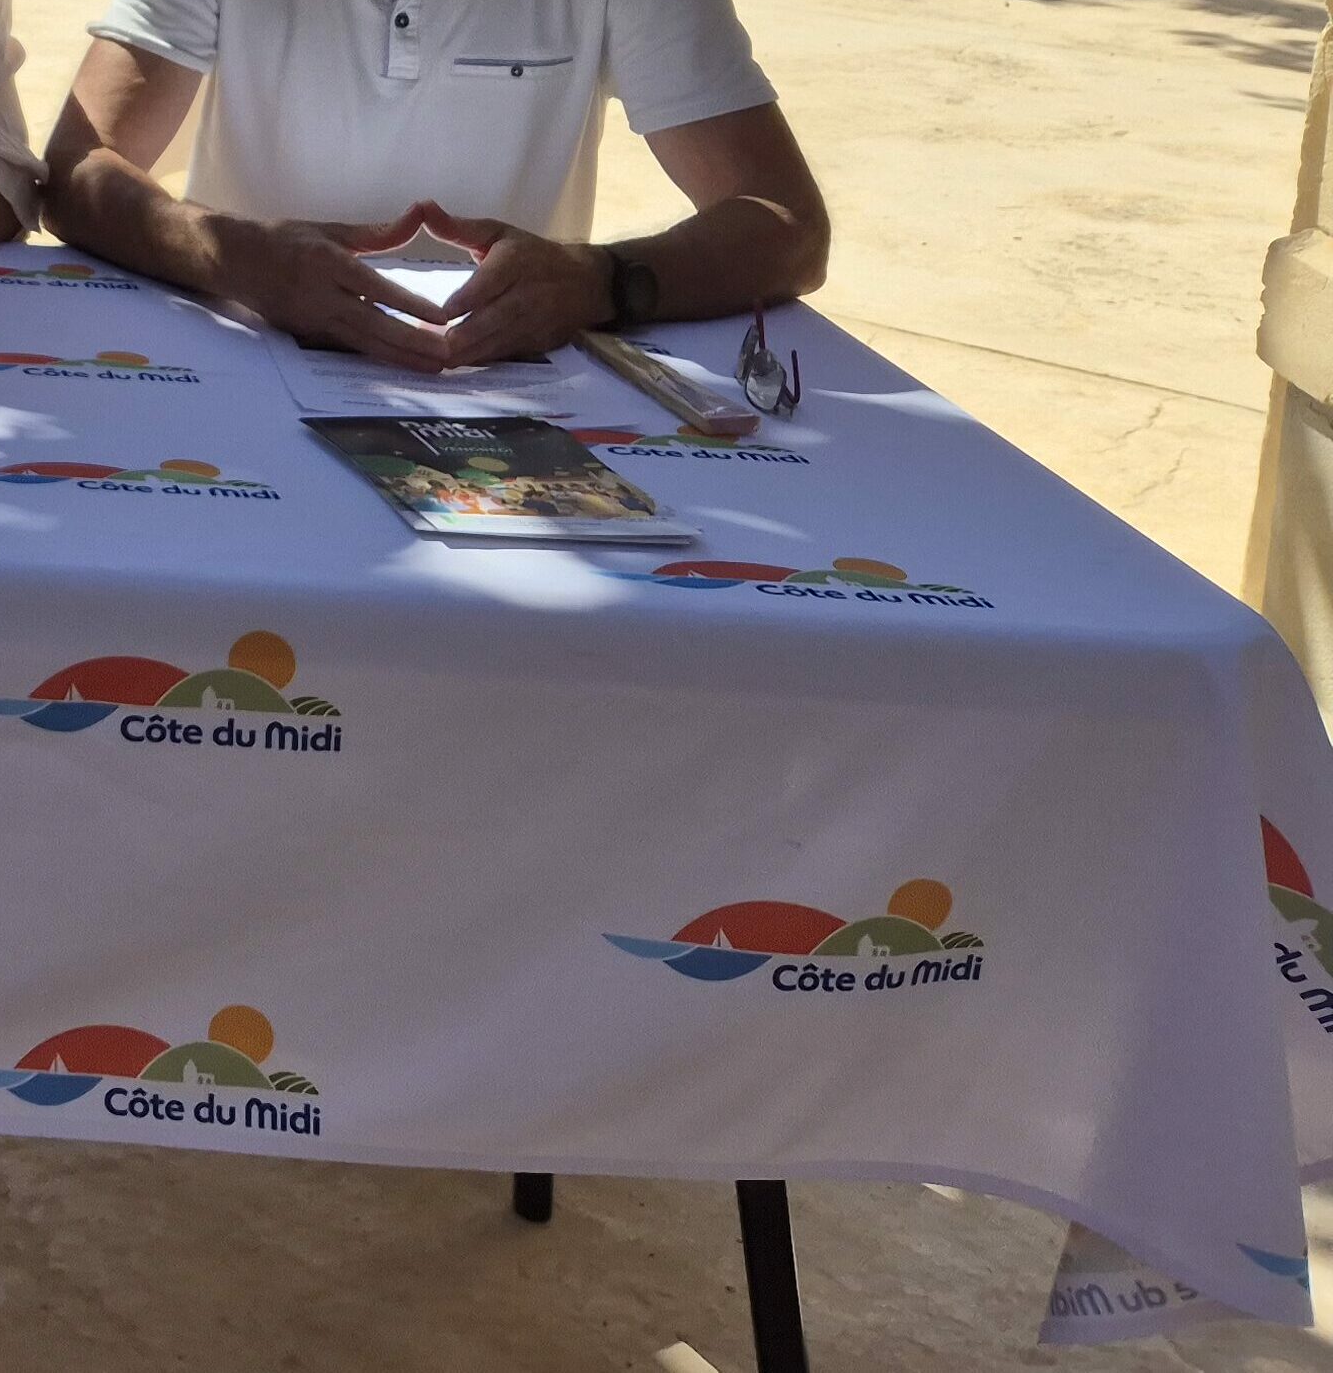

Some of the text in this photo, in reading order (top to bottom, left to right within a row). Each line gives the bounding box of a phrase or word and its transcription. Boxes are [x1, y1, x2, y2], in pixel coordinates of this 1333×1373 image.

[21, 366, 88, 381] Côte
[97, 368, 134, 382] du
[607, 446, 684, 458] Côte
[691, 449, 733, 460] du
[77, 478, 156, 495] Côte
[162, 482, 206, 497] du
[757, 583, 849, 603] Côte
[858, 587, 902, 605] du
[120, 714, 343, 752] Côte du Midi
[771, 954, 985, 992] Côte du Midi
[103, 1086, 322, 1136] Côte du Midi
